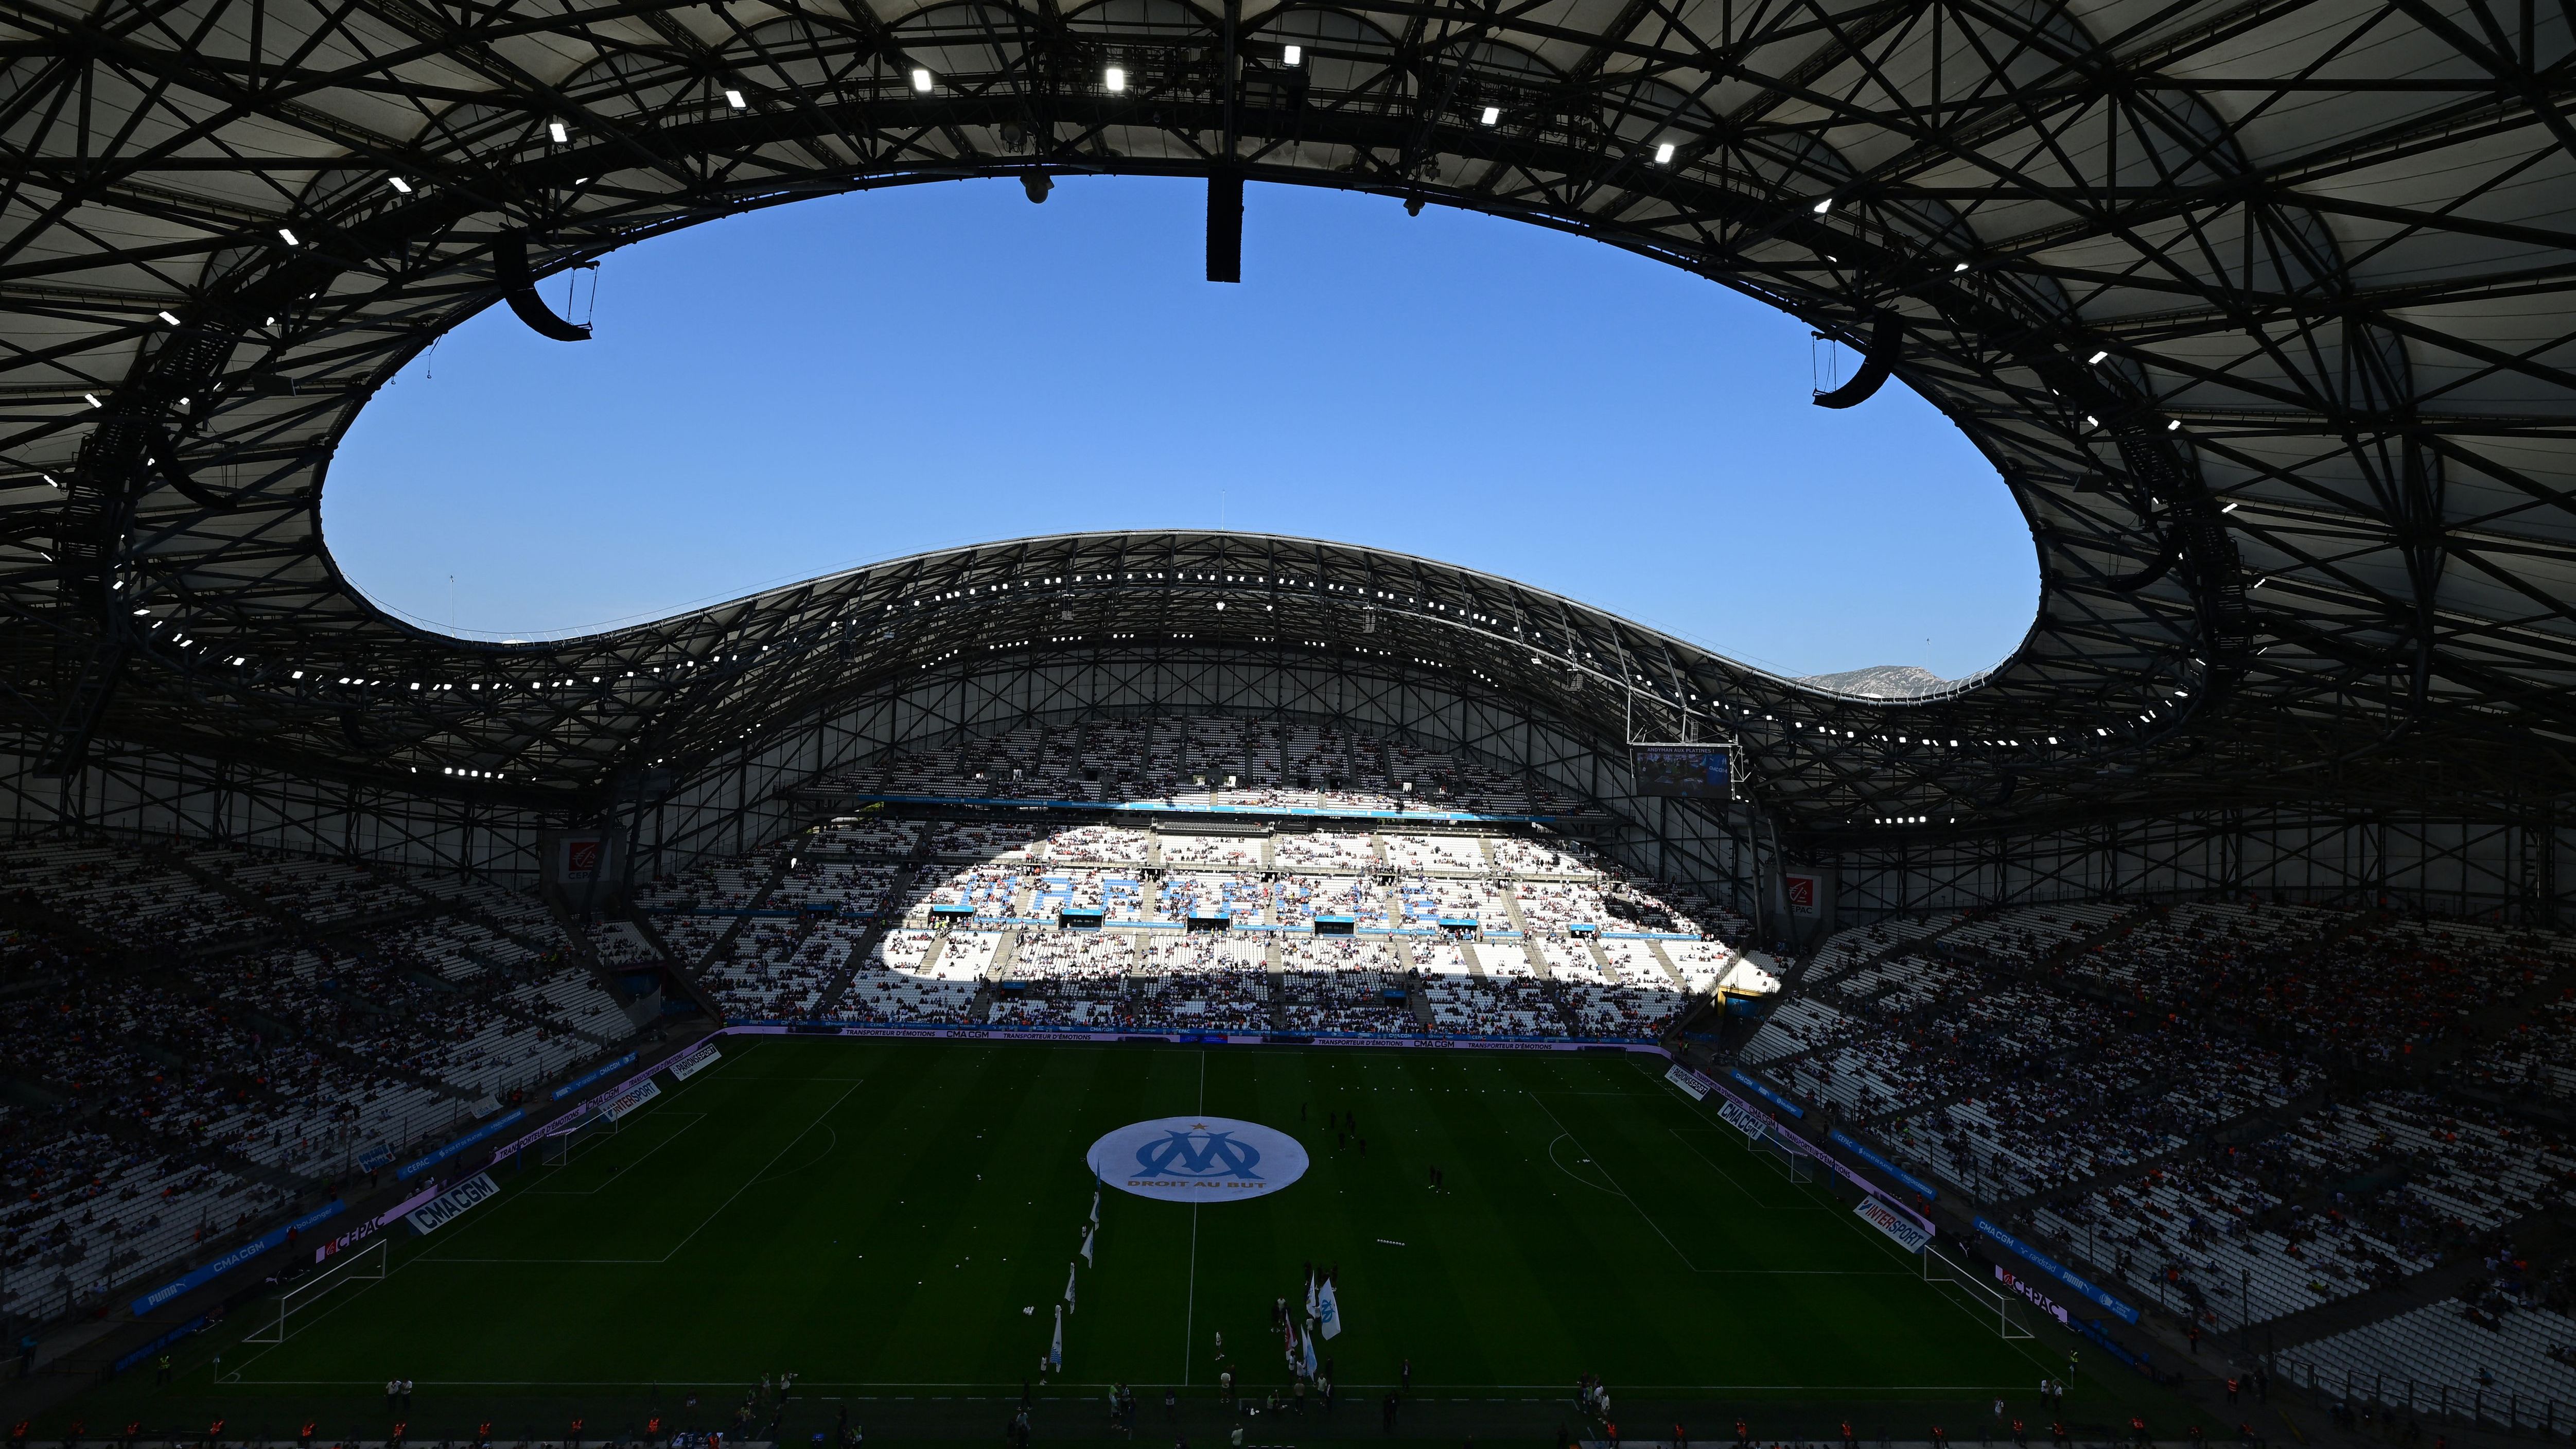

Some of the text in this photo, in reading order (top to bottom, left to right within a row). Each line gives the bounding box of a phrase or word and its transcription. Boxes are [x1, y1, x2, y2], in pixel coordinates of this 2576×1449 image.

[568, 871, 601, 880] CEP
[1783, 905, 1812, 914] EPAC
[599, 1065, 611, 1076] CMA
[628, 1052, 684, 1087] TRANSPORTEUR D'ÉMOTIONS
[676, 1046, 715, 1074] PARIONSSPORT
[1673, 1068, 1710, 1094] PARIONSSPORT
[1696, 1072, 1722, 1092] TRANSPORTEUR
[1721, 1088, 1744, 1107] D'ÉMOTIONS
[588, 1087, 620, 1110] CMA CGM
[612, 1082, 656, 1114] INTERSPORT
[1721, 1103, 1763, 1138] CMA CGM
[1749, 1105, 1777, 1130] CMA CGM
[467, 1131, 483, 1144] PLATINE
[500, 1109, 580, 1158] TRANSPORTEUR D'ÉMOTIONS
[1837, 1134, 1853, 1147] CEPAC
[407, 1157, 430, 1174] CEPAC
[1784, 1130, 1851, 1178] TRANSPORTEUR D'ÉMOTIONS
[414, 1176, 495, 1230] CMA CGM
[296, 1208, 333, 1229] boulanger
[337, 1213, 386, 1249] CEPAC
[1865, 1204, 1924, 1246] INTERSPORT
[1978, 1220, 2014, 1247] CMA CGM
[213, 1240, 266, 1273] CMA CGM
[2028, 1252, 2057, 1273] randstad
[2062, 1271, 2084, 1290] PUMA
[148, 1284, 178, 1306] PUMA
[2013, 1280, 2061, 1318] CEPAC
